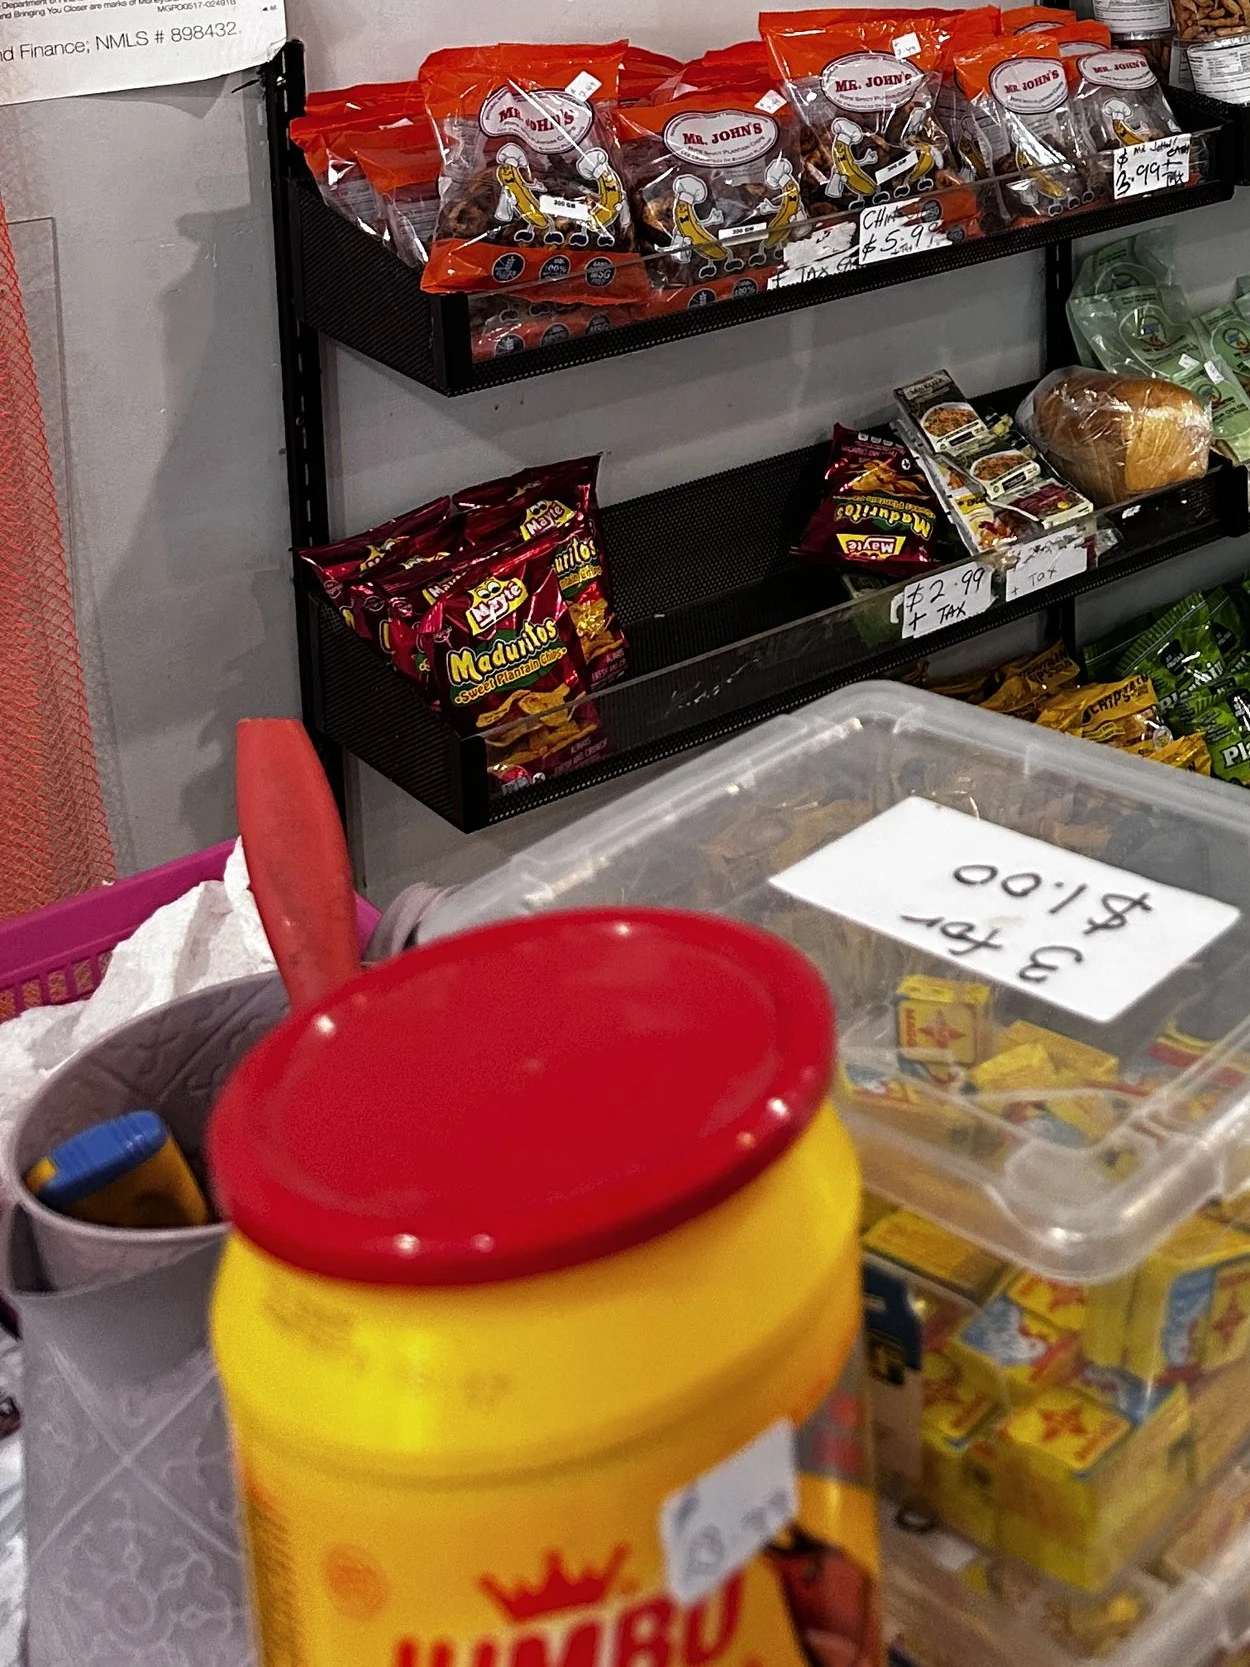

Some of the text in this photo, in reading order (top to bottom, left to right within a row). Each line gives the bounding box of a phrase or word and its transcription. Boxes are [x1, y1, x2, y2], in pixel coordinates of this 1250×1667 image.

[1, 0, 48, 11] Department
[14, 7, 46, 19] Bringing
[48, 6, 62, 15] You
[64, 4, 88, 14] Closer
[20, 39, 91, 60] Finance;
[95, 30, 150, 51] NMLS
[154, 29, 164, 44] #
[835, 71, 913, 92] MR. JOHN'S
[1004, 83, 1021, 94] MR.
[1022, 70, 1060, 90] JOHN'S
[1093, 60, 1148, 75] MR. JOHN'S
[682, 122, 763, 146] MR. JOHN'S
[834, 503, 932, 539] Maduritos
[555, 537, 597, 573] uritos
[472, 580, 522, 624] Mayté
[907, 566, 985, 612] $2.99
[936, 600, 966, 625] TAX
[449, 620, 557, 683] Maduritos
[460, 648, 563, 704] Sweet Plantain Chips
[952, 862, 1152, 936] $1.00
[900, 910, 1084, 984] 3 for
